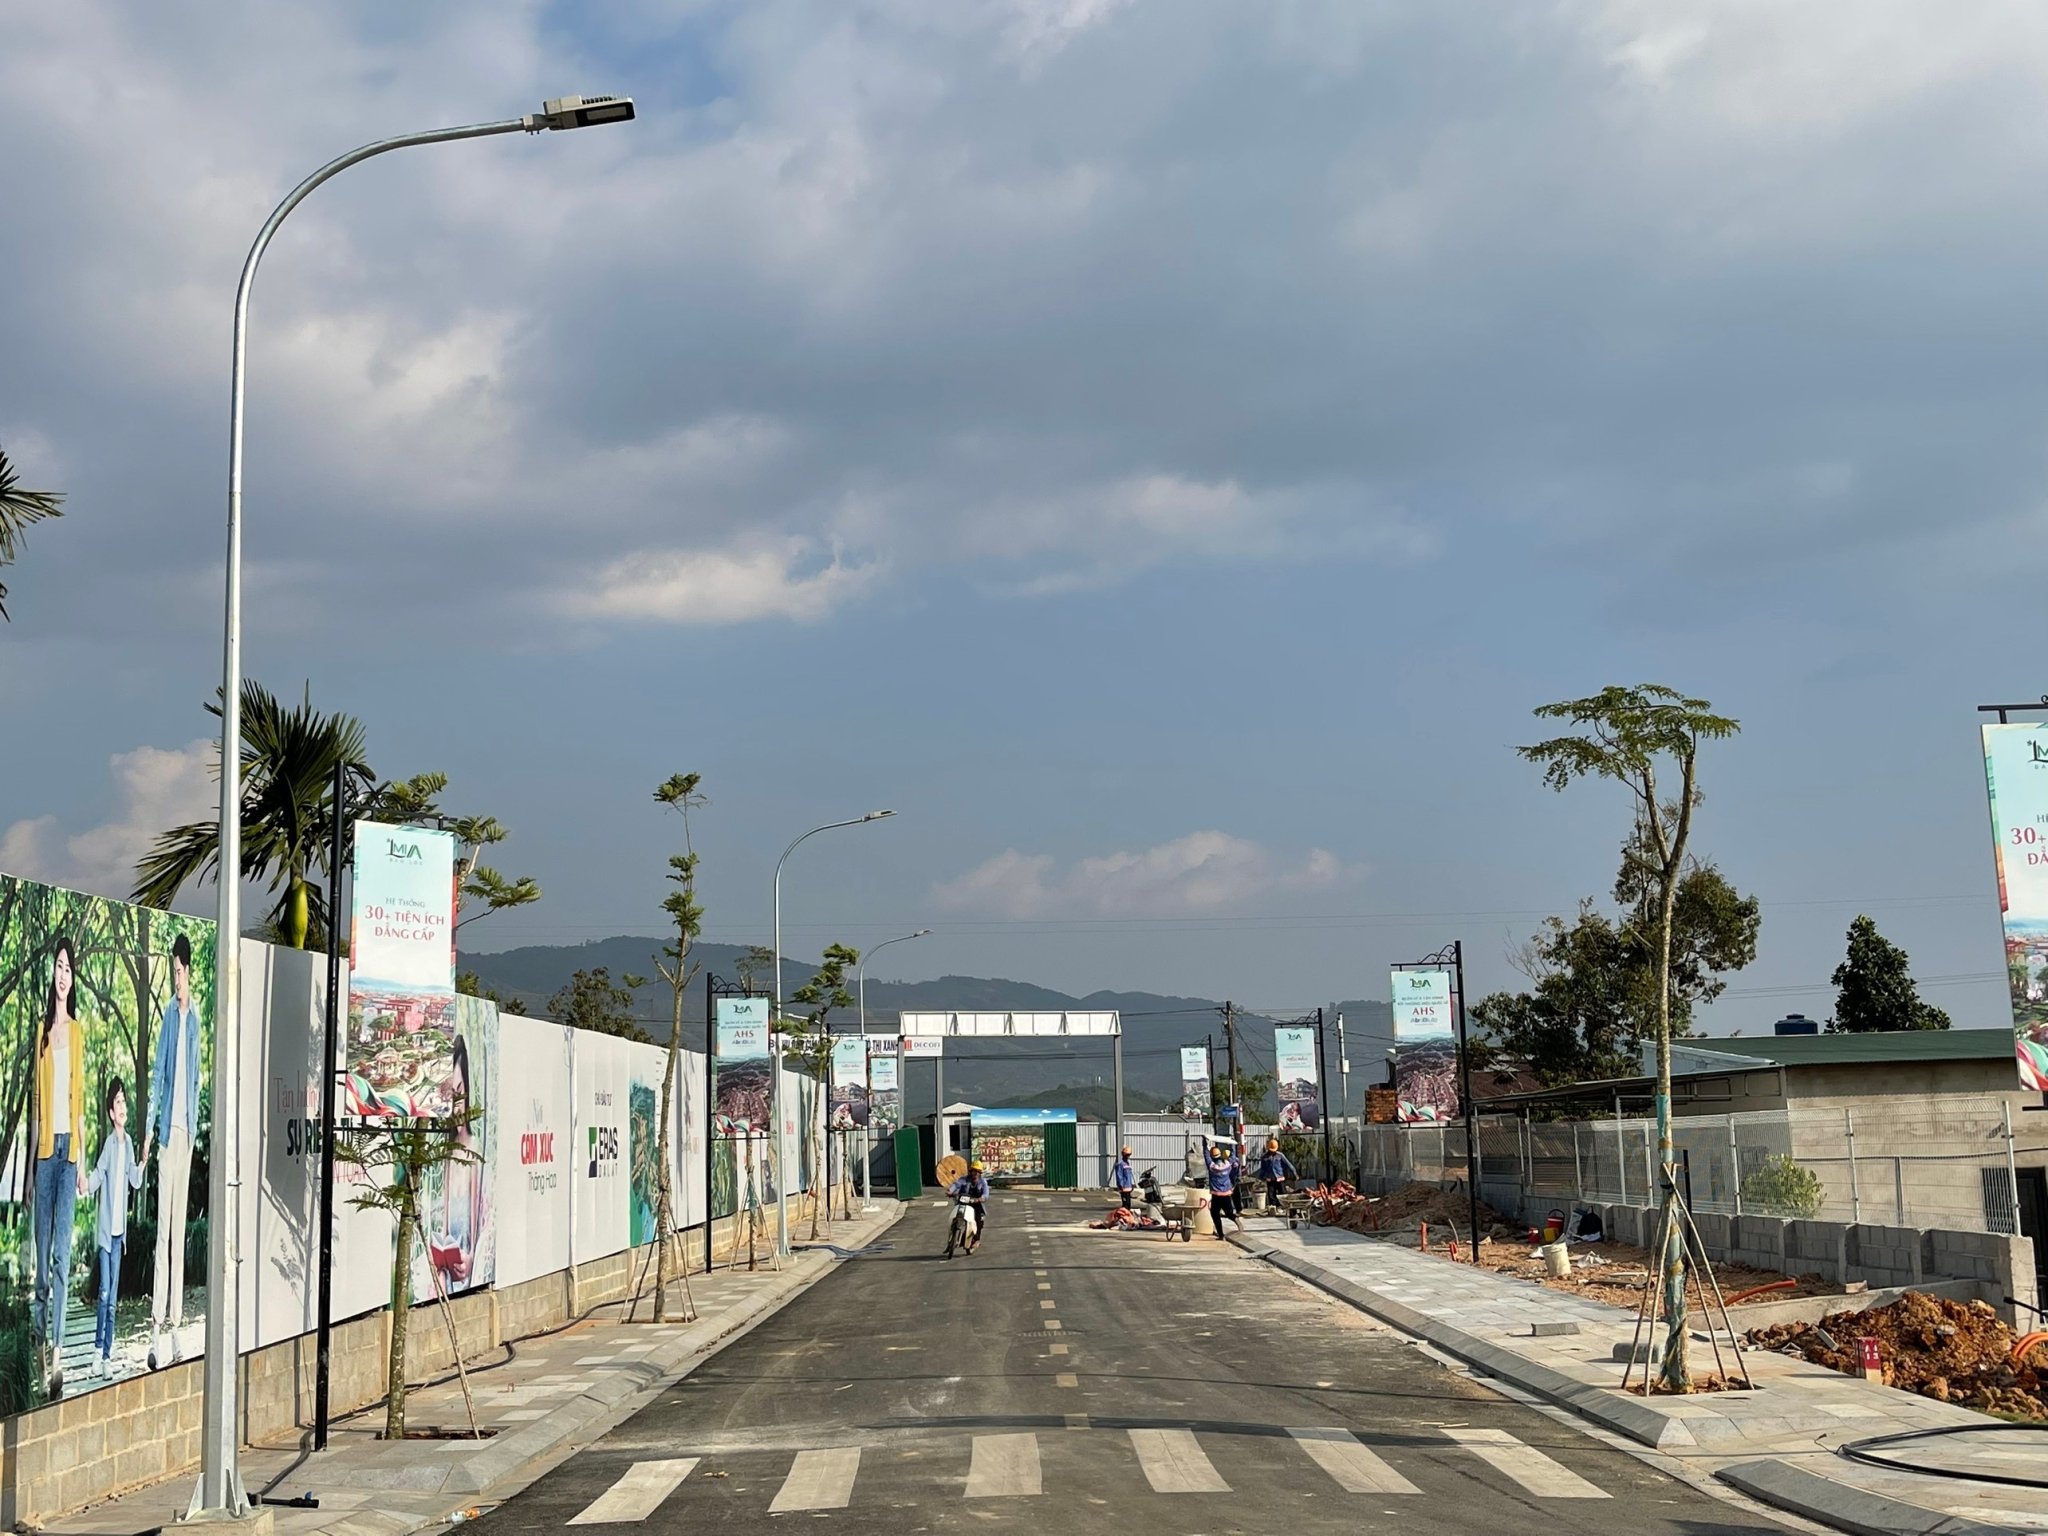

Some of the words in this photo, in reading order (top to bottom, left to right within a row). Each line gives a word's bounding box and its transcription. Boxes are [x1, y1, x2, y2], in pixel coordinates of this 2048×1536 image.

[2011, 827, 2047, 845] 30+
[365, 904, 391, 920] 30+
[394, 911, 421, 926] TIỆN
[424, 911, 444, 925] ÍCH
[413, 927, 435, 940] CẤP
[1413, 1006, 1435, 1016] AHS
[735, 1030, 754, 1039] AHS
[599, 1127, 618, 1160] ERAS
